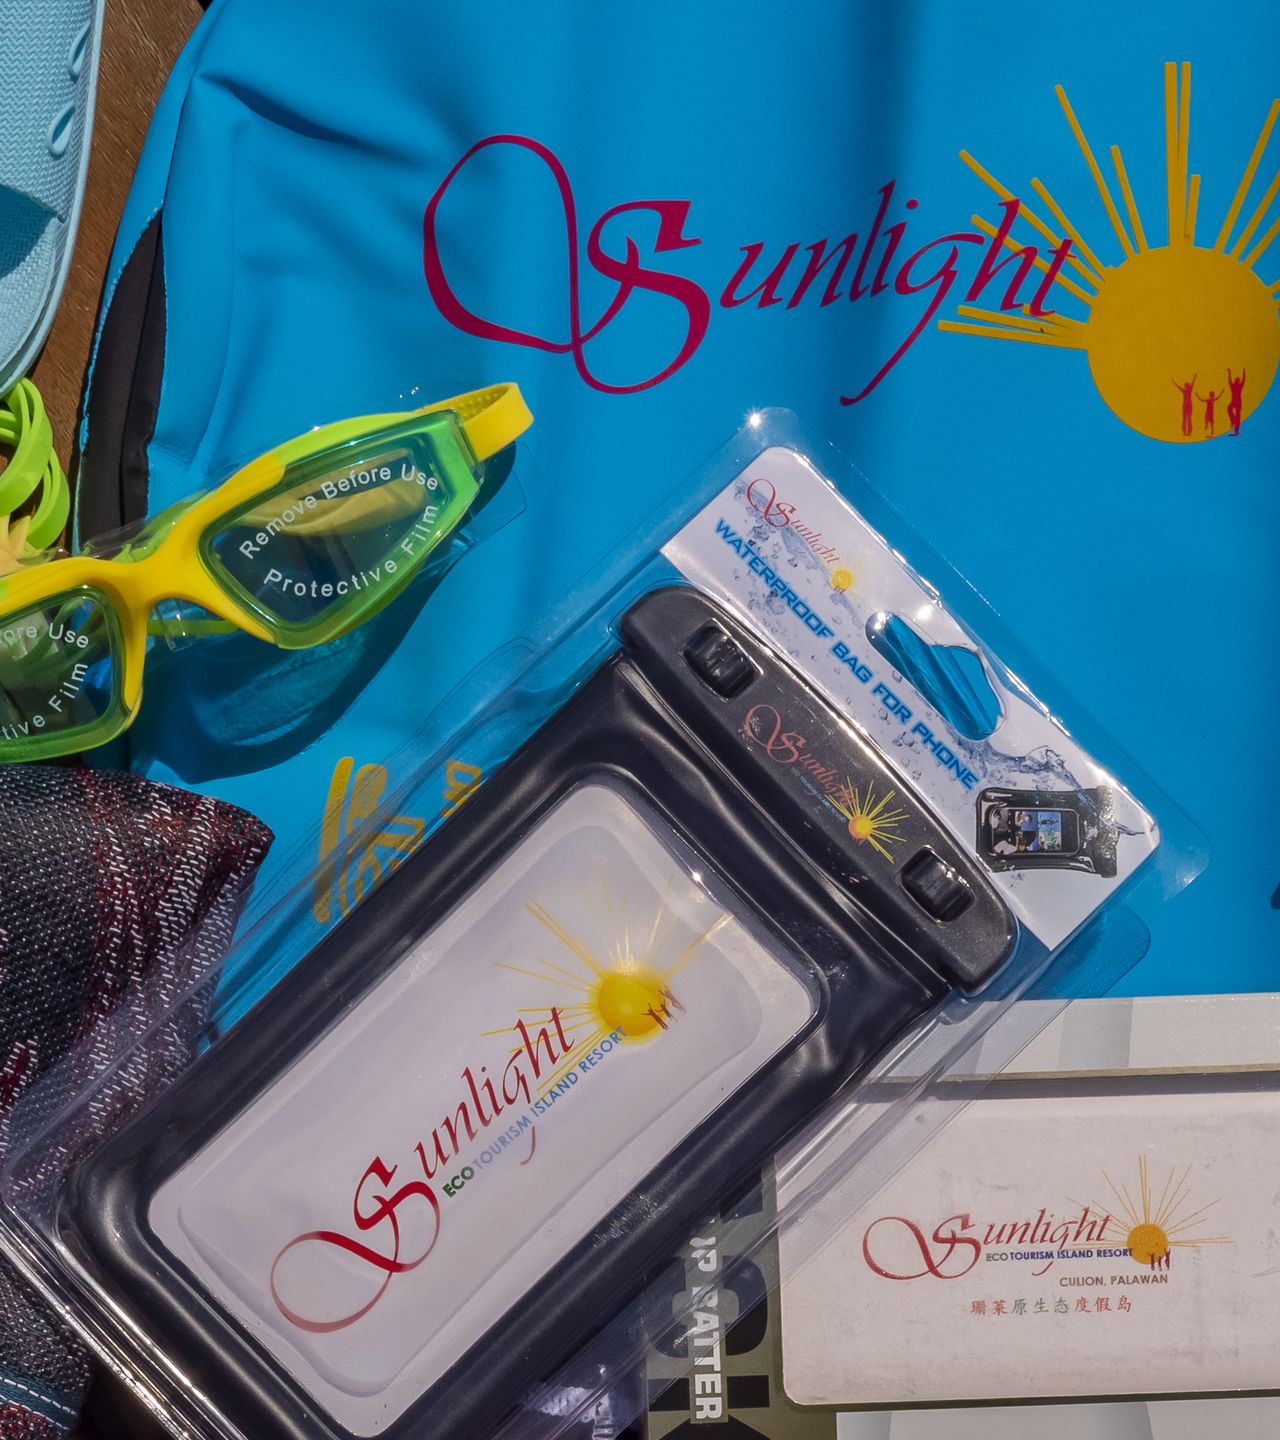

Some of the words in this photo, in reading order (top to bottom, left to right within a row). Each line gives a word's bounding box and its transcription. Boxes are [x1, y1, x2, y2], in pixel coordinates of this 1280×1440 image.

[423, 134, 1082, 407] Sunlight
[239, 495, 317, 559] Remove
[321, 465, 392, 499] Before
[401, 464, 438, 490] Use
[263, 559, 398, 598] Protective
[401, 505, 438, 556] Film
[746, 478, 841, 565] Sunlight
[48, 622, 89, 649] Use
[713, 516, 836, 642] WATERPROOF
[830, 639, 877, 686] BAG
[871, 681, 915, 724] FOR
[911, 720, 980, 791] PHONE
[48, 662, 89, 713] Film
[442, 1166, 476, 1199] ECO
[473, 1114, 533, 1173] TOURISM
[530, 1071, 579, 1119] ISLAND
[578, 1026, 628, 1075] RESORT
[270, 1006, 577, 1334] Sunlight
[862, 1206, 1112, 1281] Sunlight
[985, 1252, 1008, 1262] ECO
[1009, 1250, 1055, 1261] TOURISM
[1056, 1249, 1094, 1260] ISLAND
[1096, 1248, 1133, 1259] RESORT
[1059, 1276, 1108, 1288] CULION,
[1110, 1273, 1169, 1286] PALAWAN
